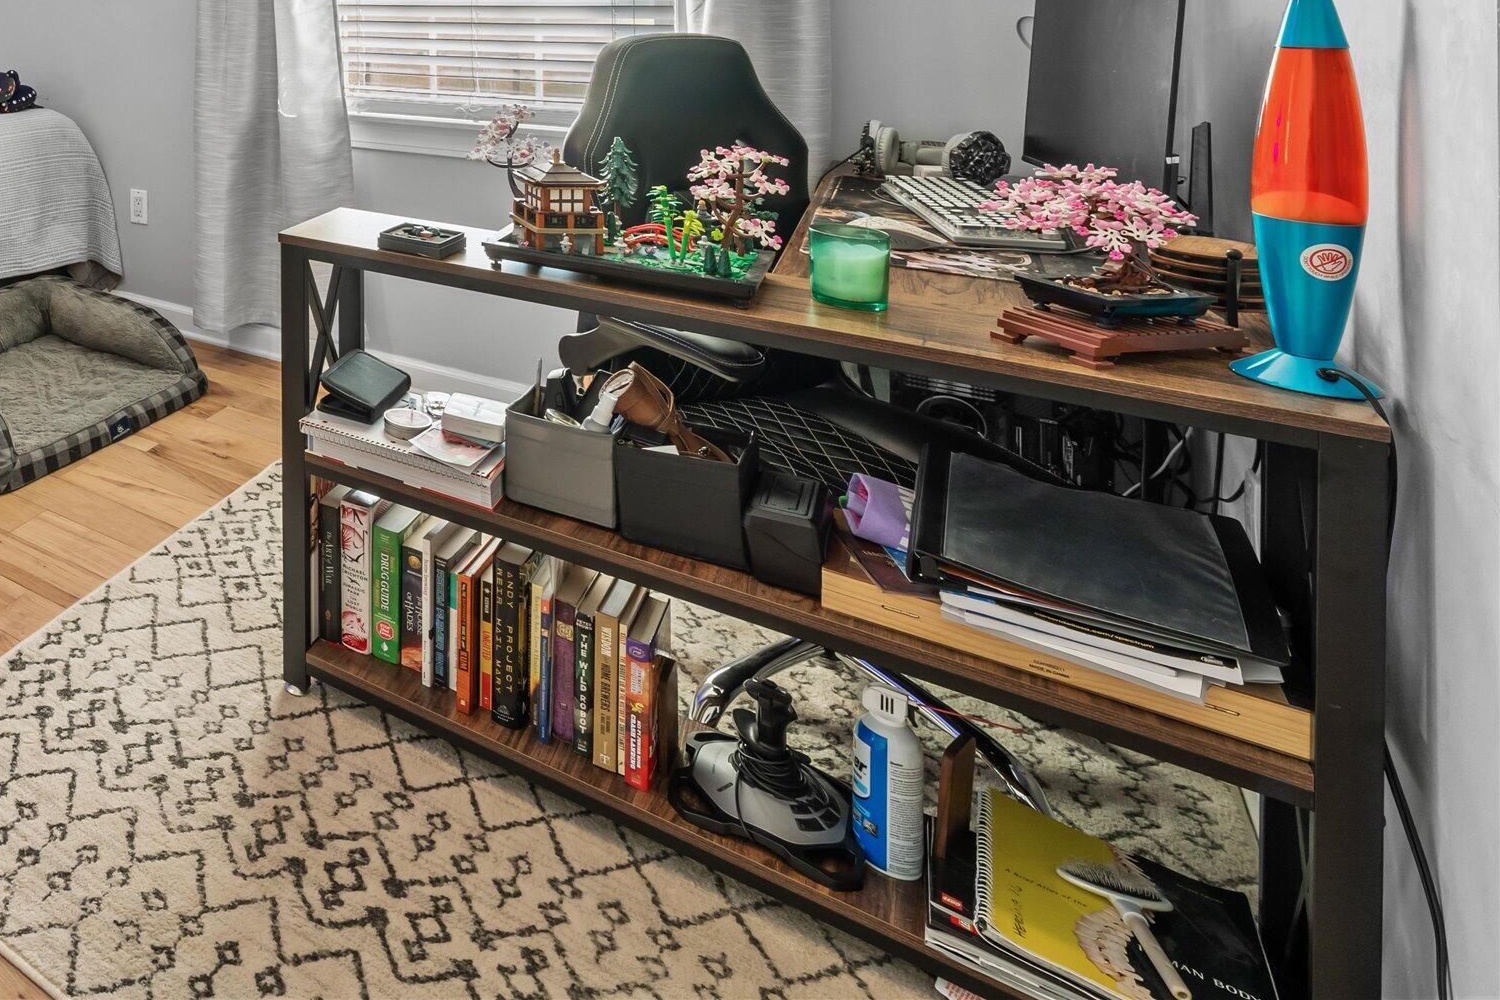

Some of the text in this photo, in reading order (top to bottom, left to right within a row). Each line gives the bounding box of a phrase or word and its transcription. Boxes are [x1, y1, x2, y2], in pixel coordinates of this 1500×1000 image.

[325, 541, 334, 558] ART
[325, 566, 334, 584] WAR
[341, 568, 368, 581] CRICHTON
[342, 563, 366, 576] MICHAEL
[380, 552, 390, 581] DRUG
[343, 582, 366, 593] JURASSIC
[347, 588, 360, 596] PARK
[380, 581, 390, 611] GUIDE
[506, 571, 514, 609] ANDY
[345, 603, 363, 612] WORLD
[404, 600, 414, 632] HADES
[495, 617, 503, 651] HAIL
[601, 627, 612, 658] WISDOM
[506, 625, 514, 693] PROJECT
[600, 663, 611, 682] HOME
[579, 660, 588, 692] WILD
[600, 682, 611, 712] BREWERS
[578, 694, 587, 735] ROBOT
